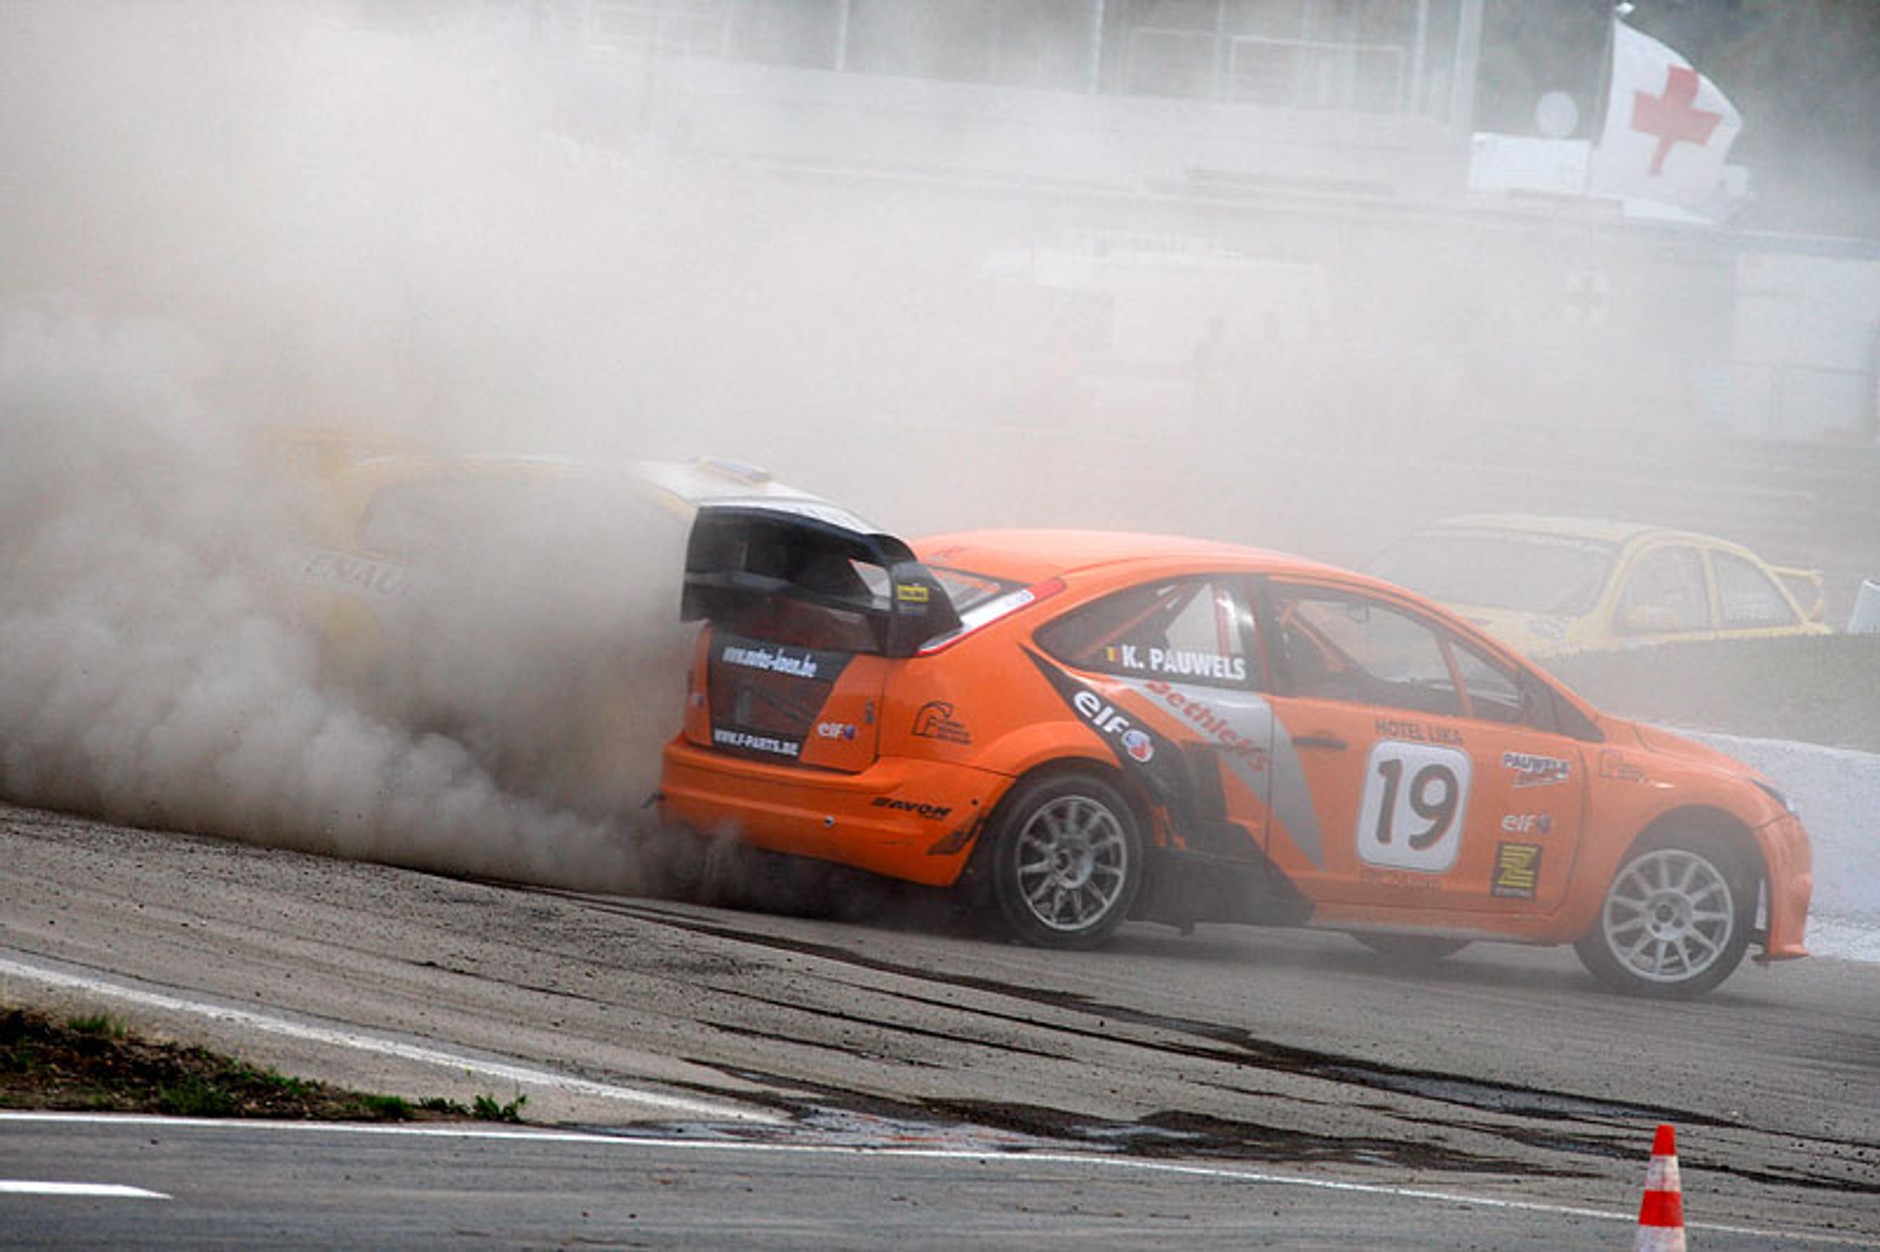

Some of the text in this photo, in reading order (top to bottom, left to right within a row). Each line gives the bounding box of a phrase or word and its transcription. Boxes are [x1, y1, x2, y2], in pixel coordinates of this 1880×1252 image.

[1120, 643, 1247, 681] K. PAUWELS
[1073, 690, 1132, 733] elf
[1374, 716, 1426, 741] HOTEL
[1375, 759, 1459, 851] 19
[1500, 812, 1537, 833] elf
